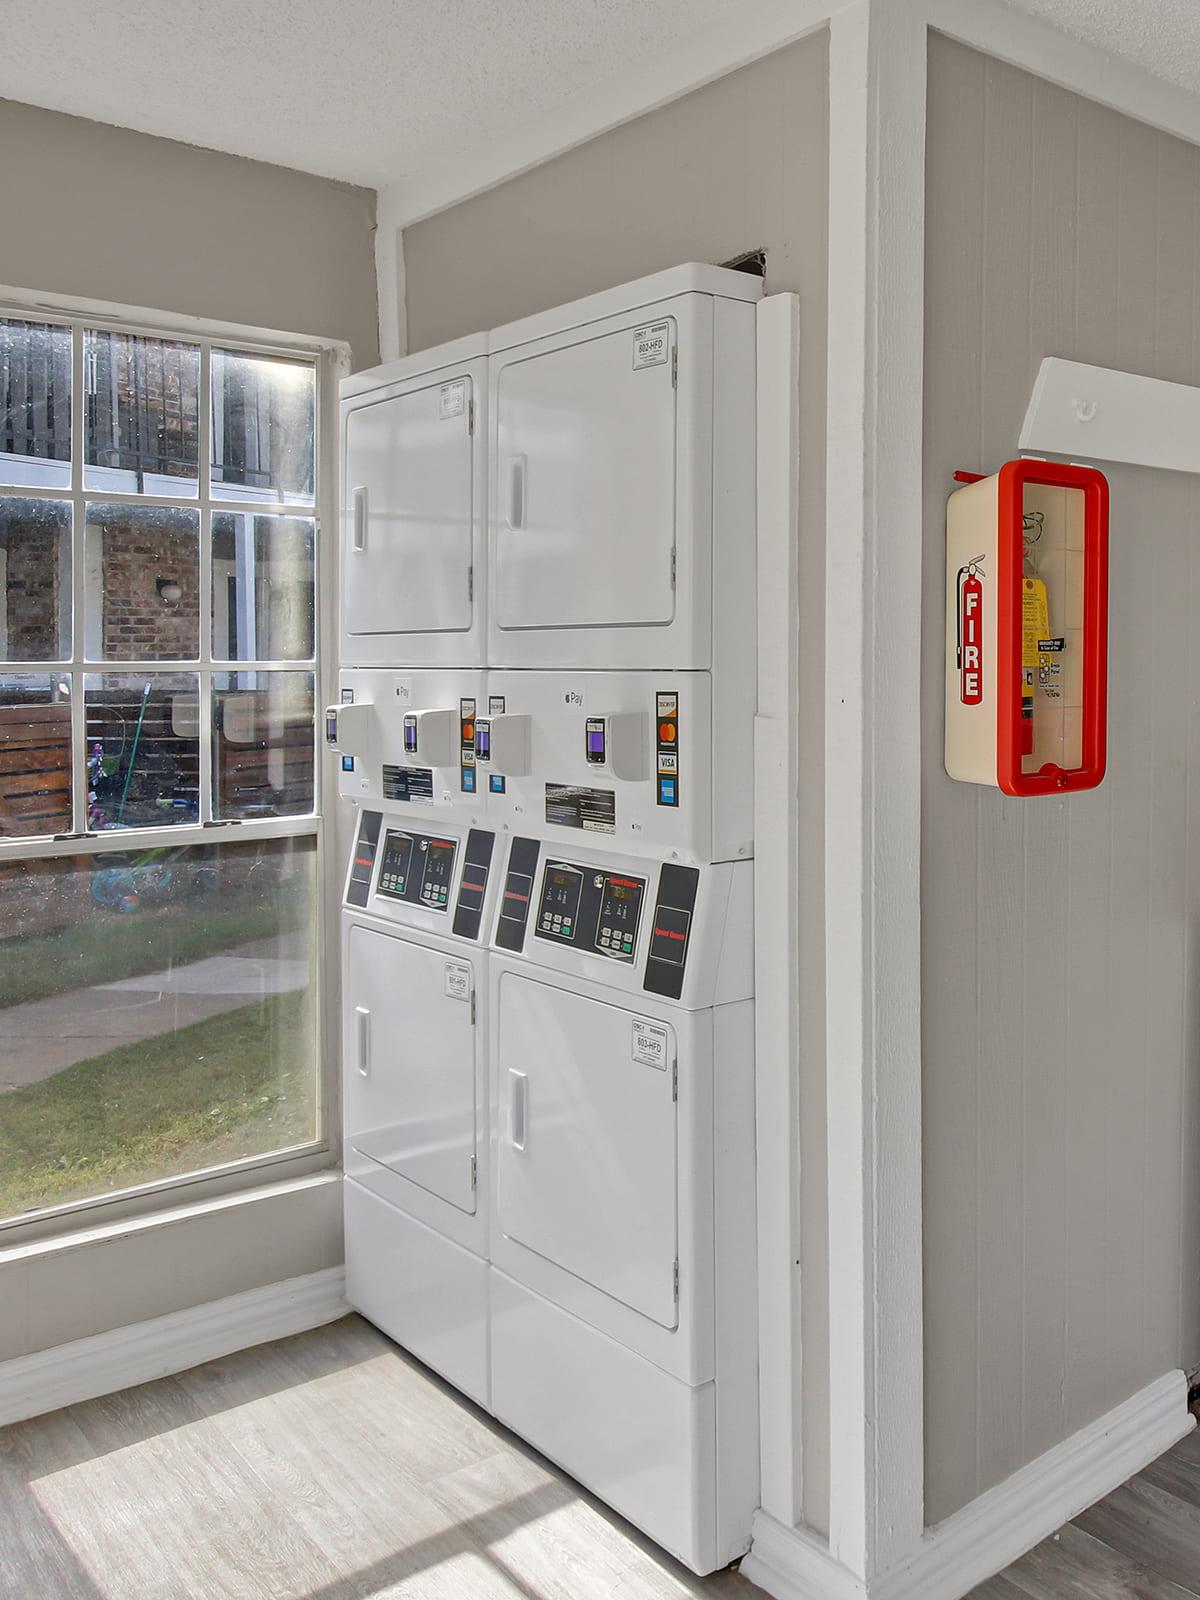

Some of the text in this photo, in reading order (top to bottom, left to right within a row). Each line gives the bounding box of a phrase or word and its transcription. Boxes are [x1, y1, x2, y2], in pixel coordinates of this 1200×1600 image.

[965, 592, 979, 697] FIRE
[571, 692, 583, 706] Pay
[661, 758, 674, 767] VISA
